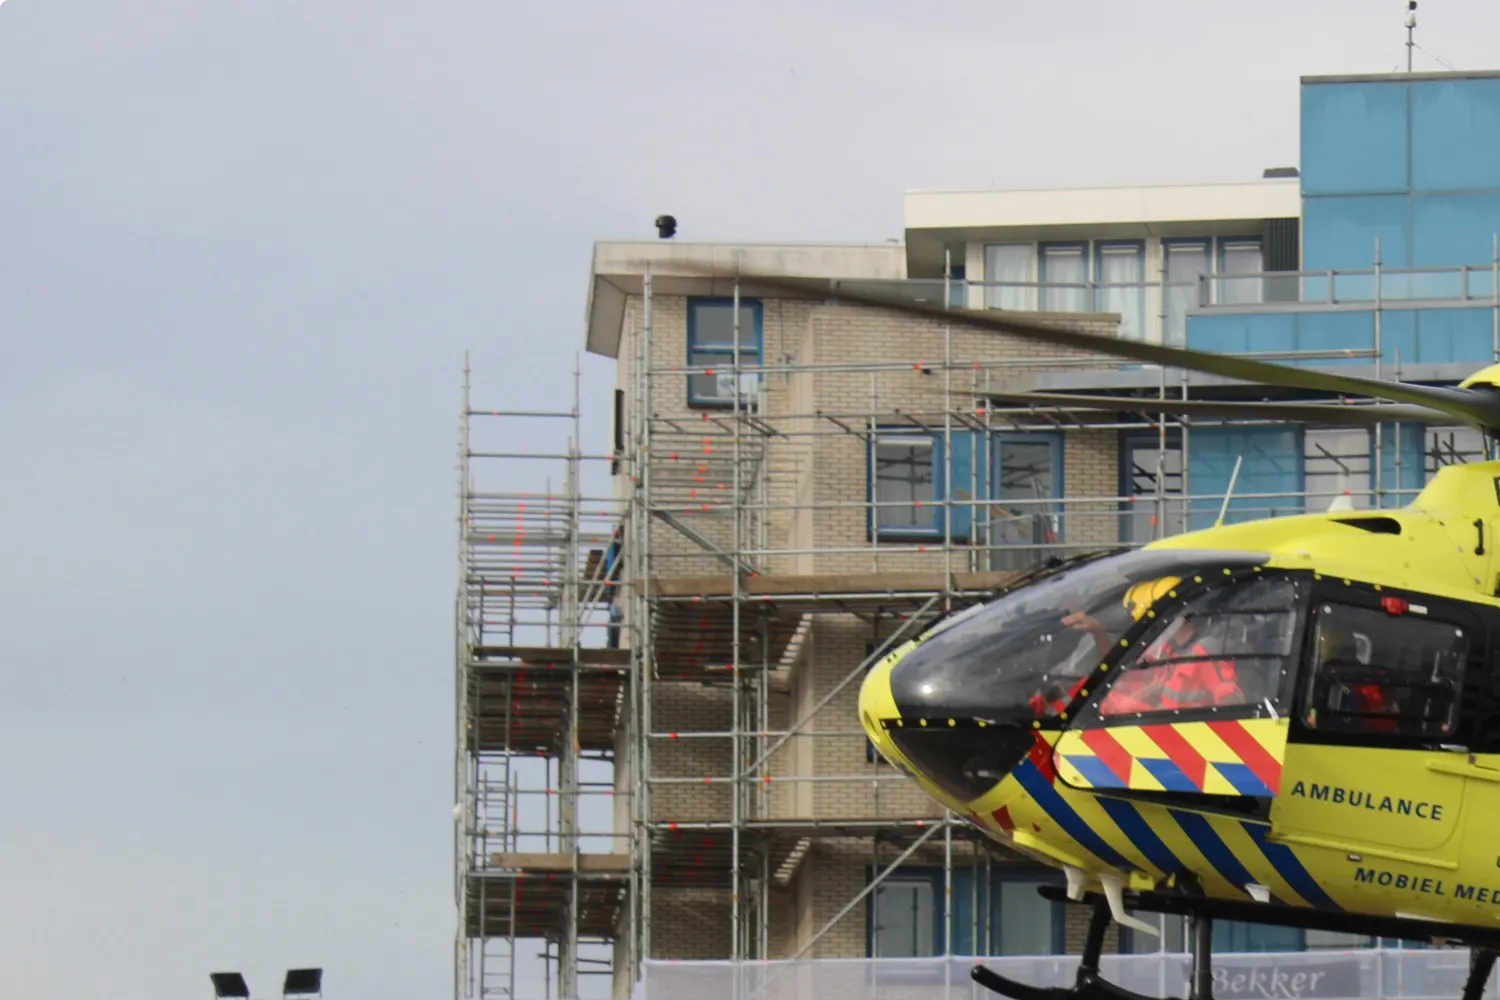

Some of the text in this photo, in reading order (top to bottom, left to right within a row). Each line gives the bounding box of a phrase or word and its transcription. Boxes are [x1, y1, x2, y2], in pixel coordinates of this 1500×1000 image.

[1291, 780, 1444, 822] AMBULANCE
[1354, 867, 1445, 896] MOBIEL
[1212, 966, 1326, 999] Bekker
